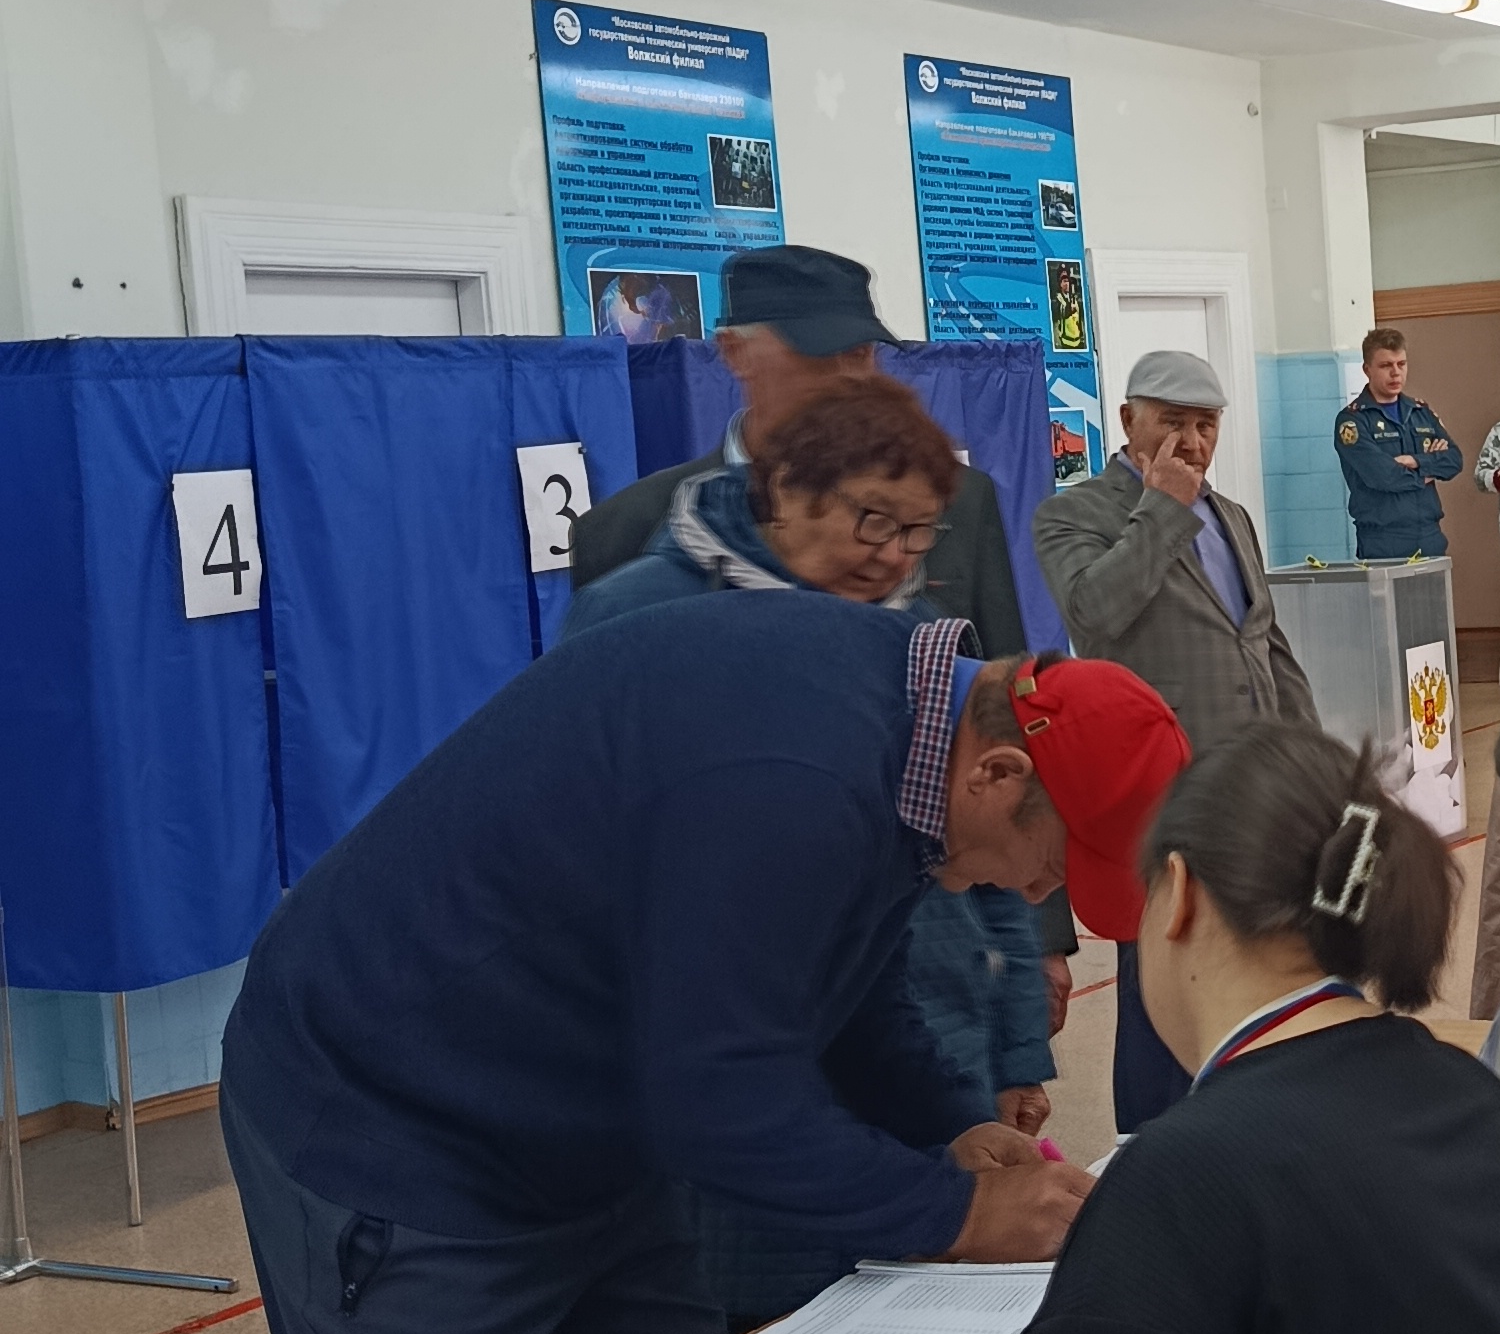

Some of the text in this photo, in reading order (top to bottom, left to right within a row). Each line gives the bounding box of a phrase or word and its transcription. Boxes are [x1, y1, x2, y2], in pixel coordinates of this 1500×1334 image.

[589, 27, 645, 44] государственный
[628, 46, 705, 71] Волжский филиал
[576, 77, 629, 91] Направление
[633, 85, 676, 97] подготовки
[542, 474, 577, 555] 3
[202, 504, 250, 596] 4
